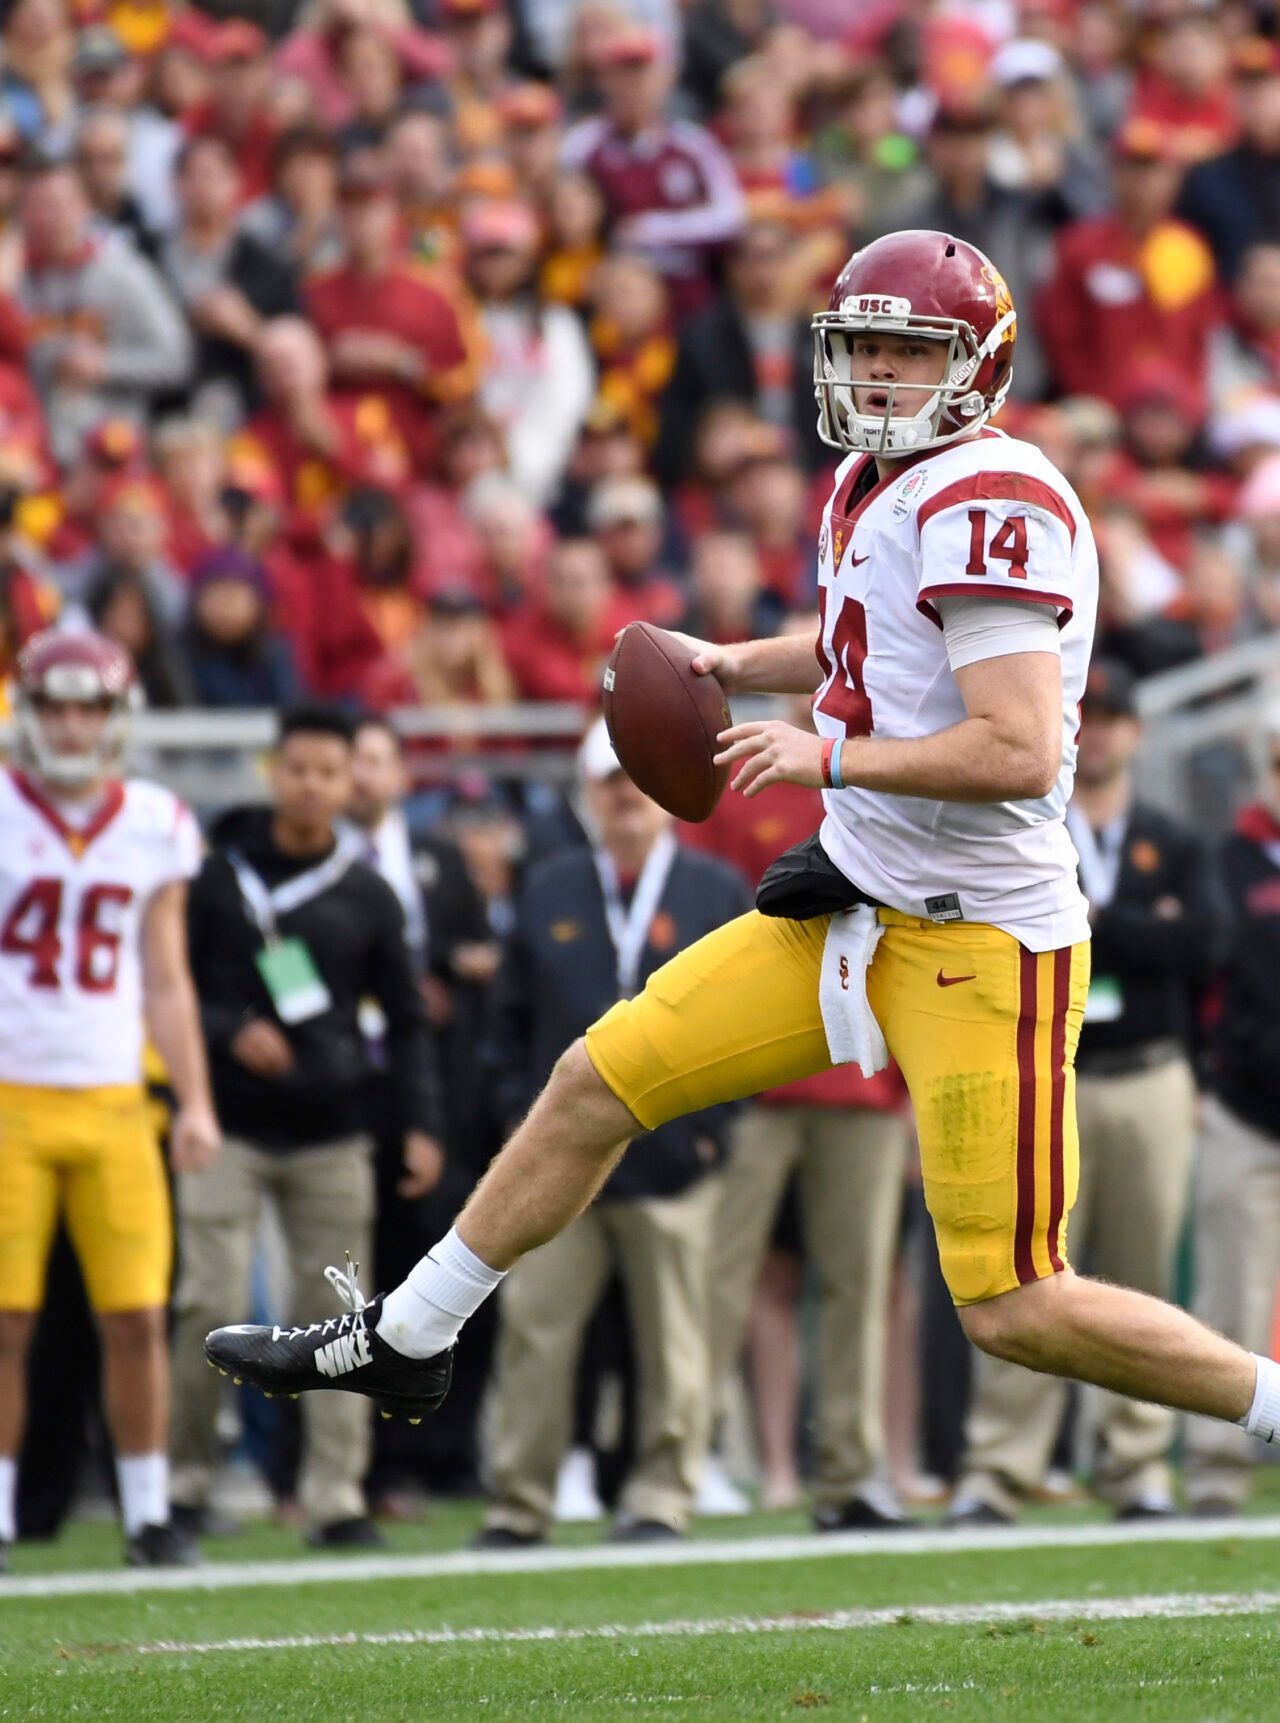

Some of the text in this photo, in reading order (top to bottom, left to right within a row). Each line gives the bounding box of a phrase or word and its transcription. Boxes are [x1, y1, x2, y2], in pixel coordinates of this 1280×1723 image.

[859, 299, 892, 313] USC
[950, 361, 974, 386] FIGHT
[966, 510, 1029, 580] 14
[0, 875, 134, 995] 46
[314, 1328, 374, 1378] NIKE
